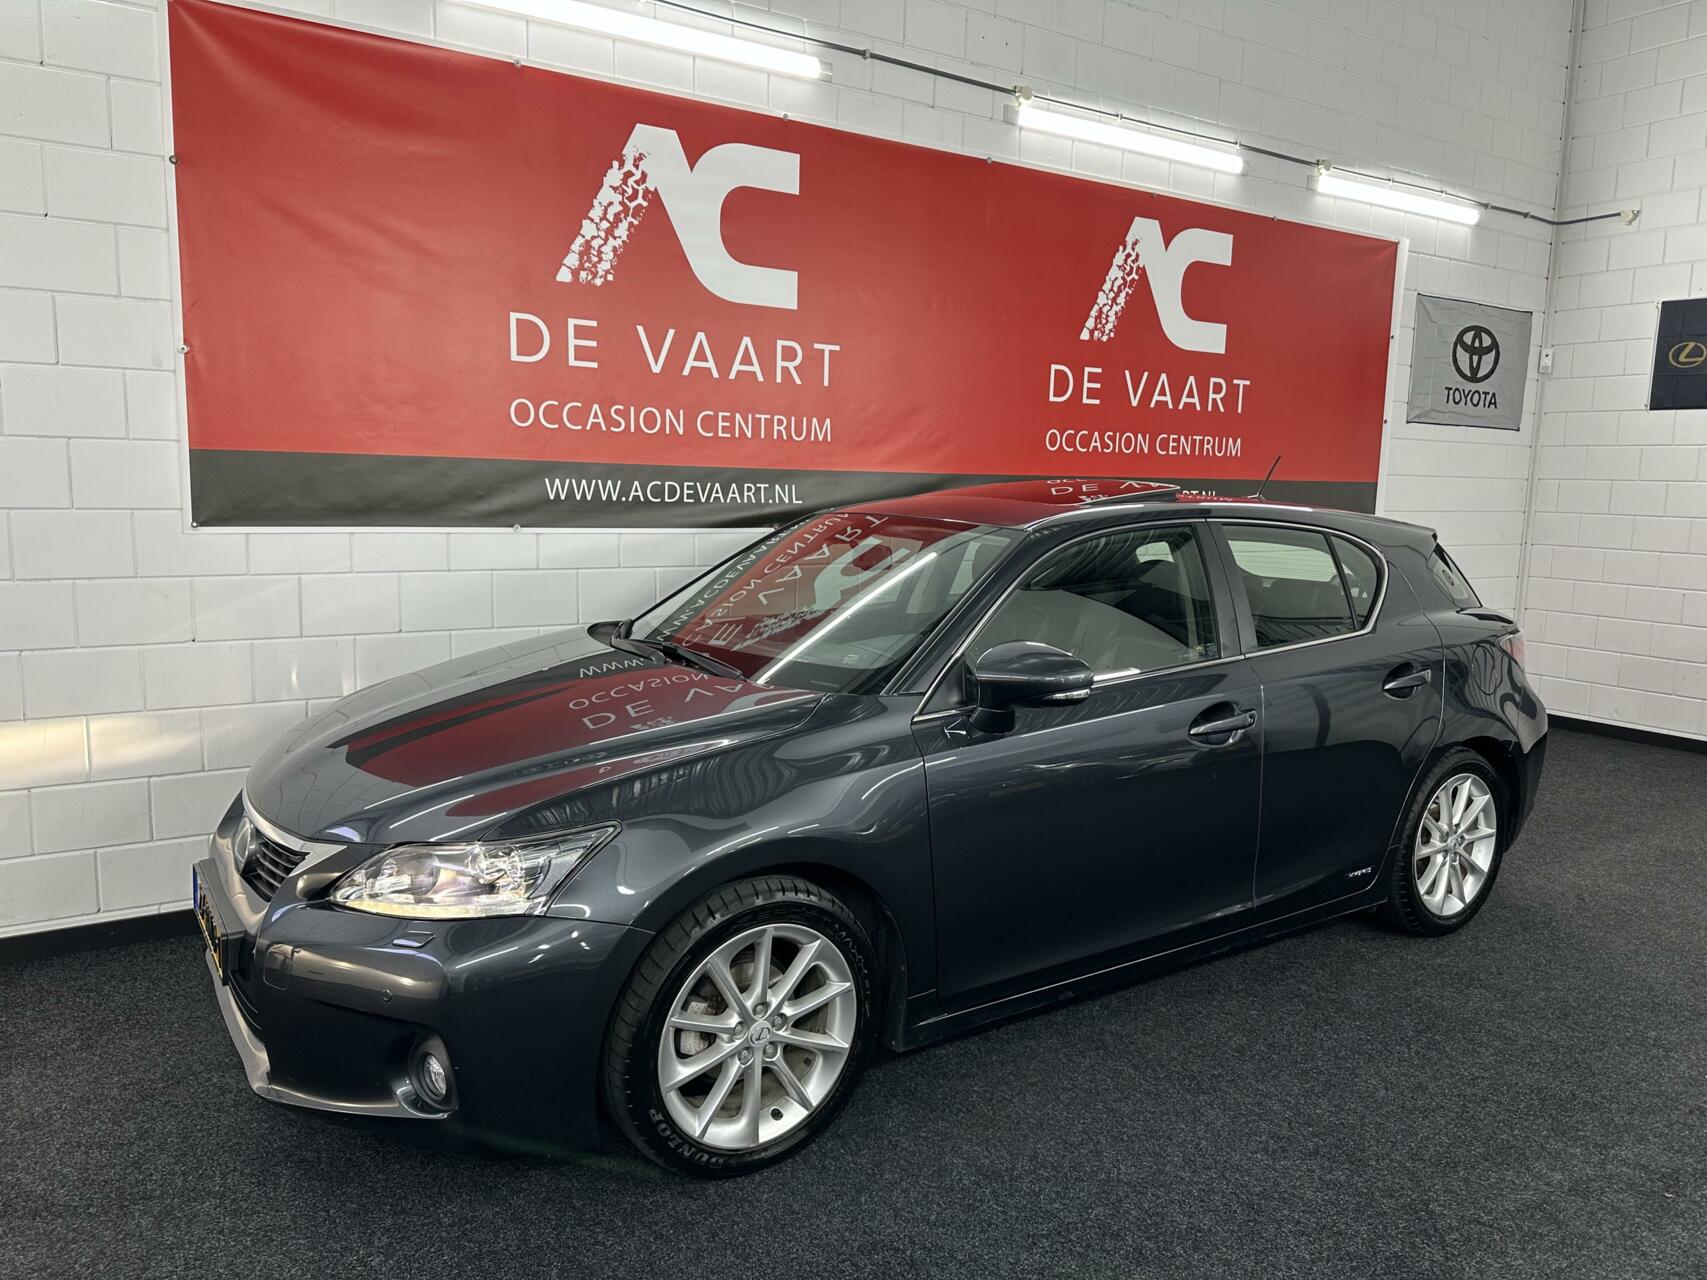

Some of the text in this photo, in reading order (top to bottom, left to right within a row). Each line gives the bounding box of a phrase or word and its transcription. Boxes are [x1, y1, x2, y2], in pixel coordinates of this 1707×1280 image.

[509, 311, 841, 387] DE VAART
[1049, 363, 1251, 414] DE VAART
[1444, 386, 1498, 410] TOYOTA
[509, 398, 832, 443] OCCASION CENTRUM
[1045, 429, 1241, 458] OCCASION CENTRUM
[545, 477, 803, 504] WWW.ACDEVAART.NL
